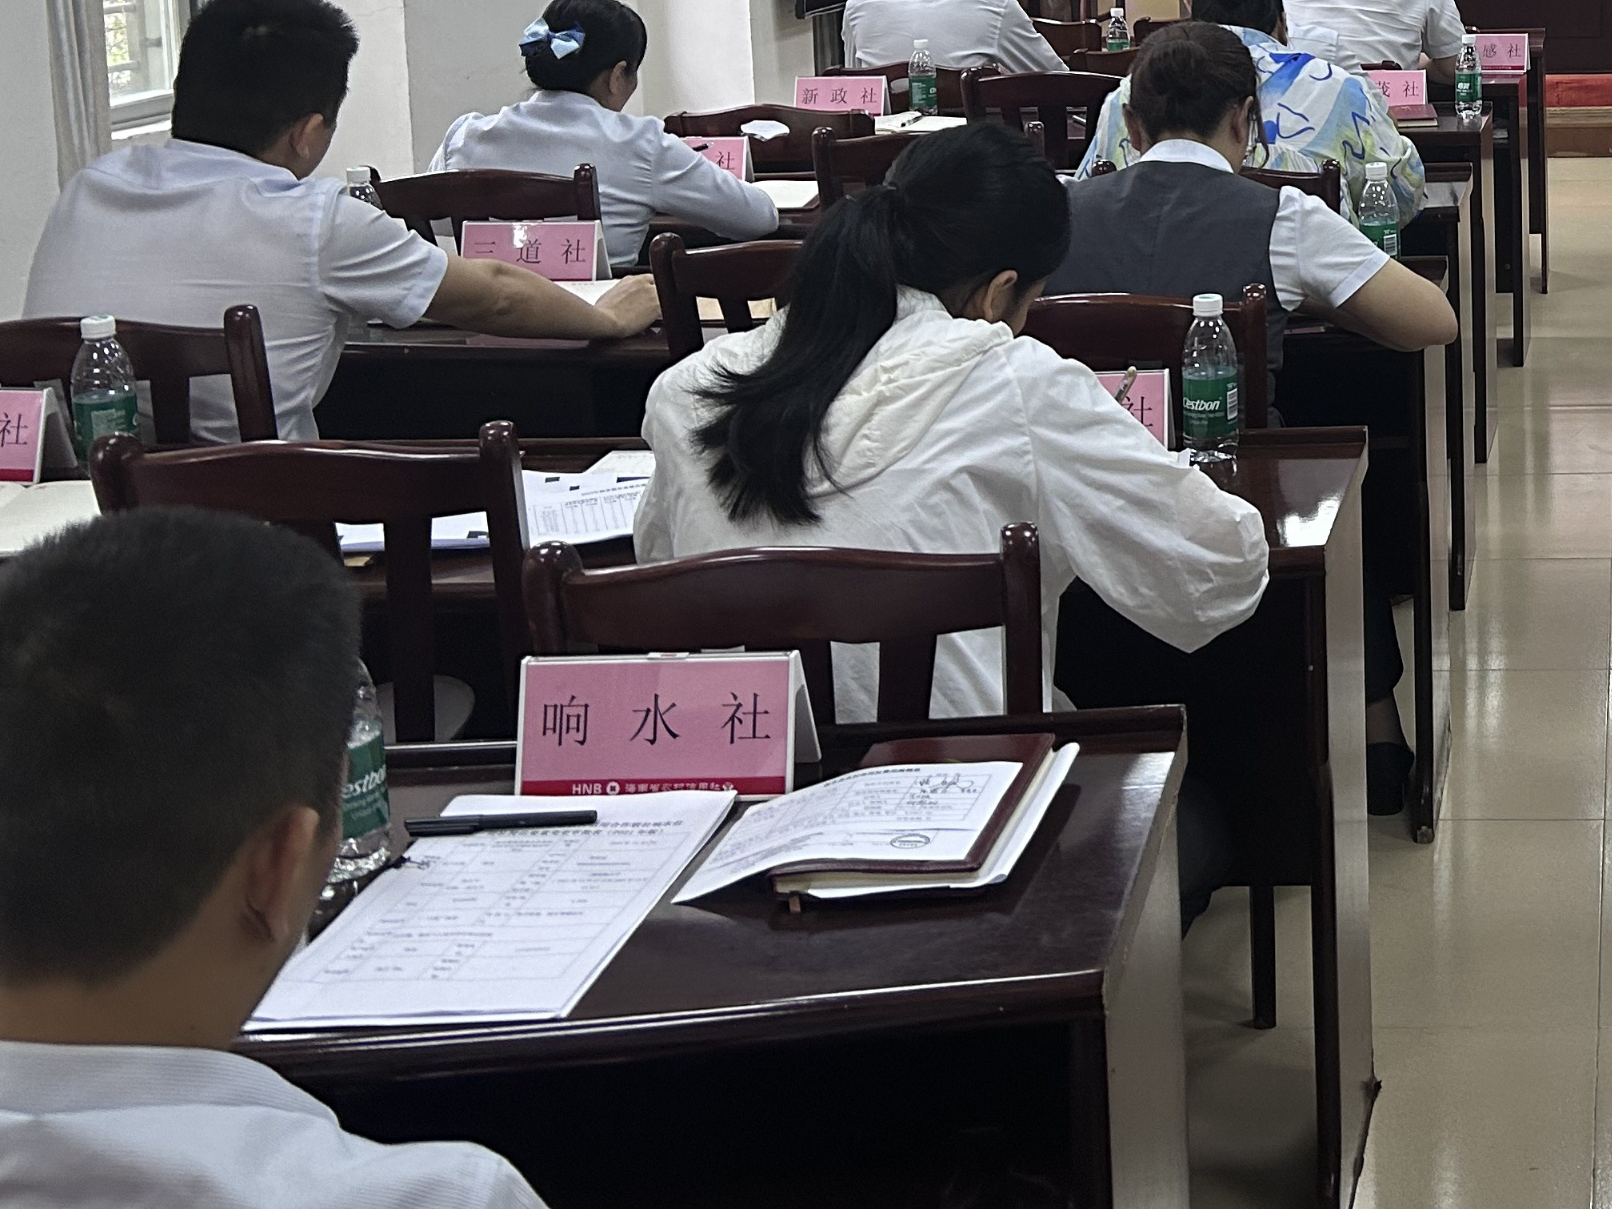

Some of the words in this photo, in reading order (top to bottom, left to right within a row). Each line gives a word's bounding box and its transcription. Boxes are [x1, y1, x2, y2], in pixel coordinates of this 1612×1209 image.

[801, 86, 878, 105] 新政社
[1182, 396, 1221, 411] Cestbon
[541, 691, 772, 747] 响水社
[571, 782, 603, 795] HNB
